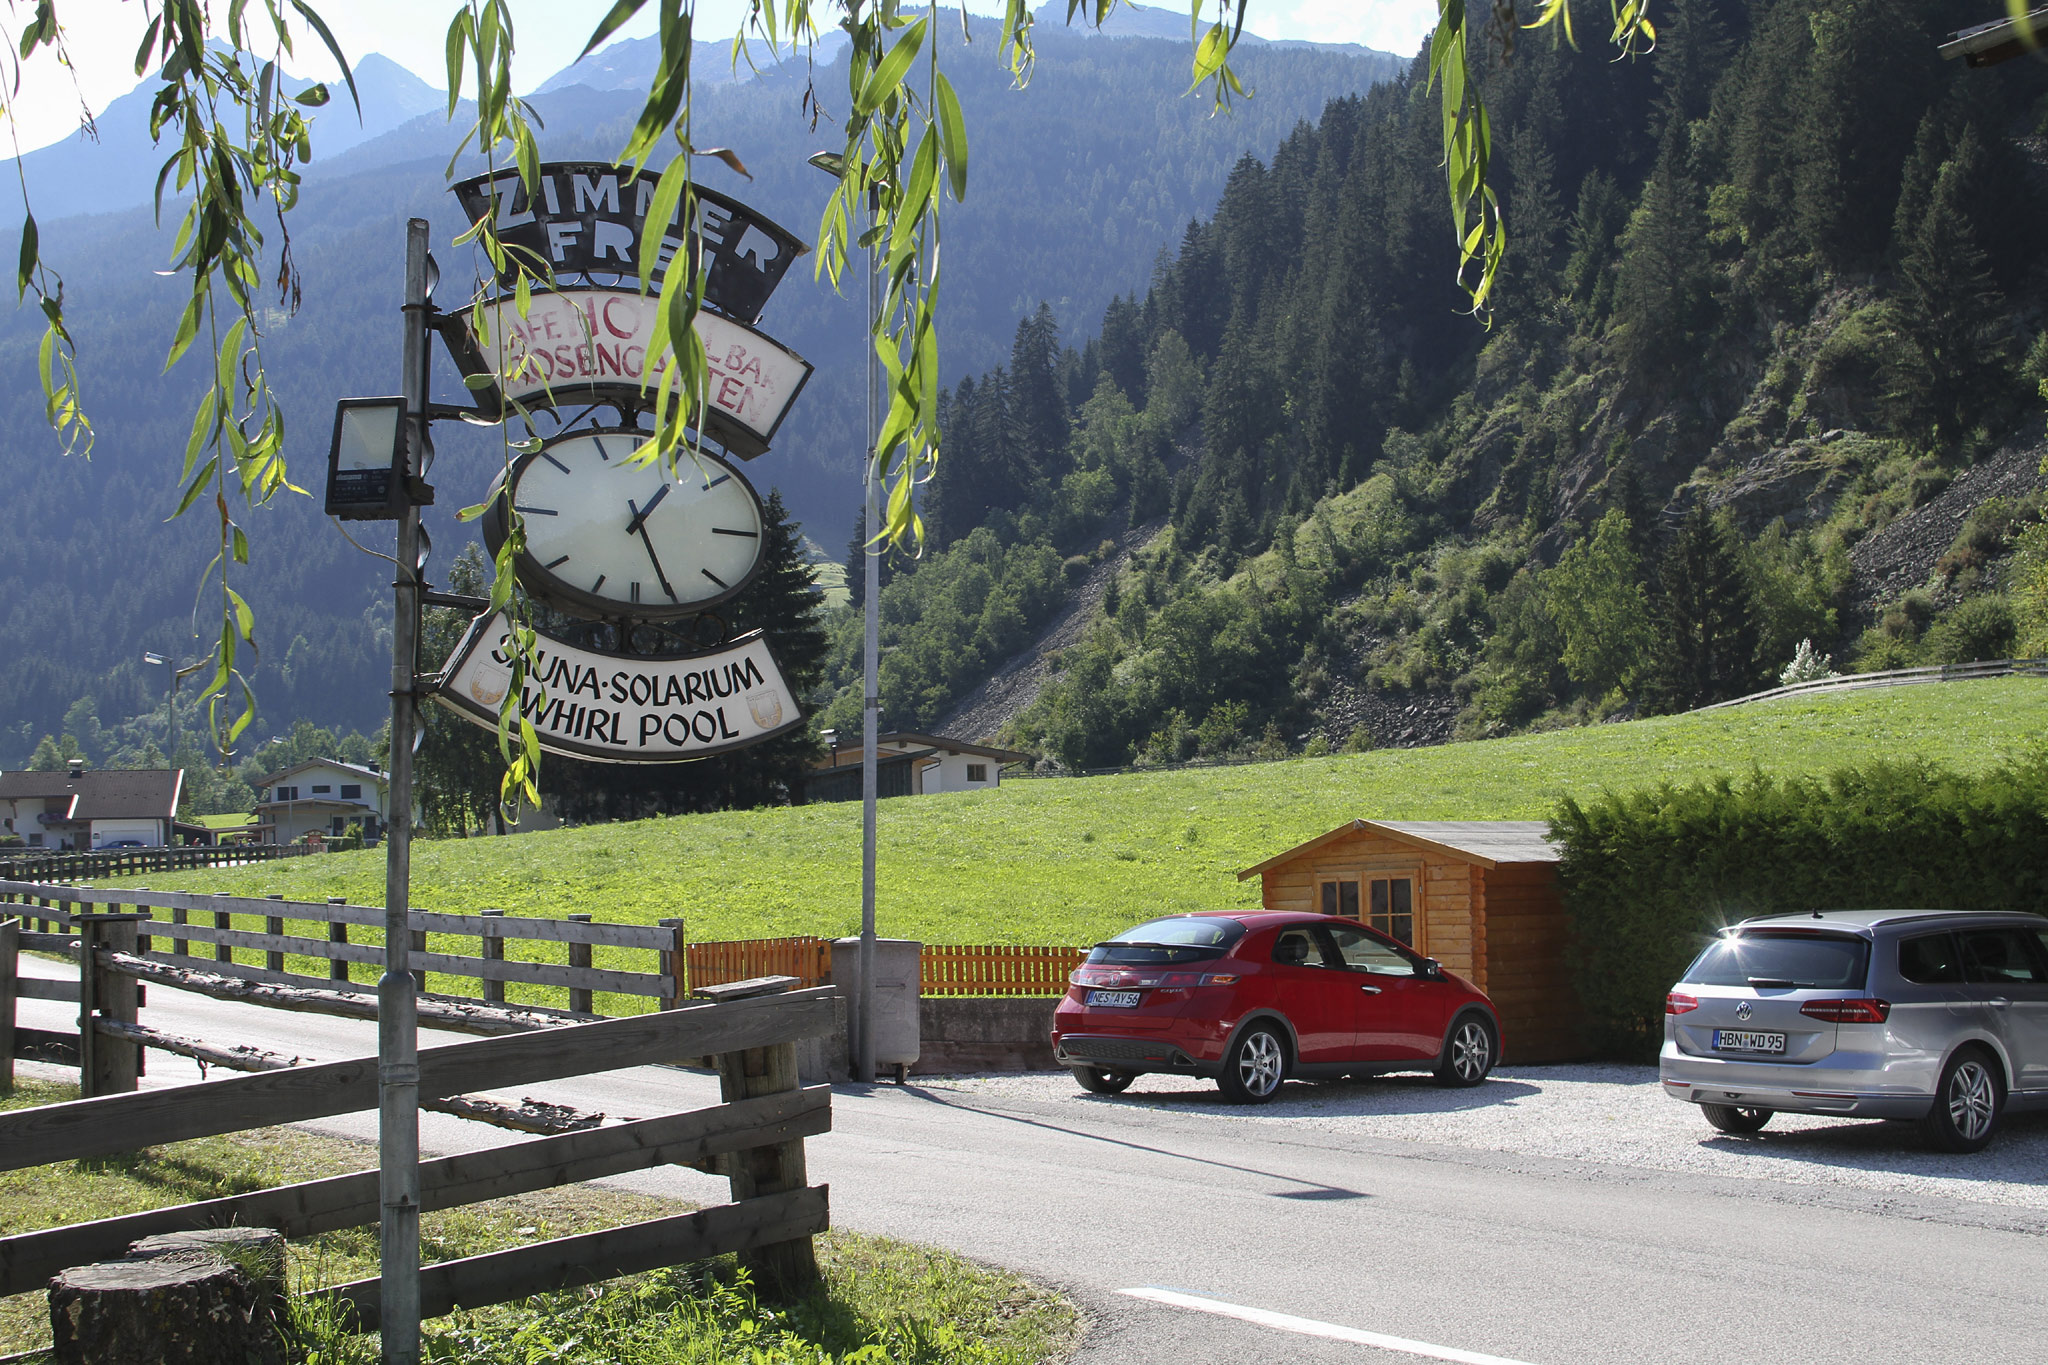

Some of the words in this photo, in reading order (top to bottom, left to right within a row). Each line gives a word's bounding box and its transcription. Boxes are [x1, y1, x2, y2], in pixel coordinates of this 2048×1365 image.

[521, 686, 628, 746] WHIRL
[639, 706, 741, 748] POOL
[1093, 992, 1111, 1003] NES
[1113, 993, 1127, 1004] AY
[1126, 994, 1138, 1005] 56
[1719, 1032, 1743, 1046] HBN
[1750, 1034, 1765, 1048] WD
[1768, 1035, 1783, 1049] 95
